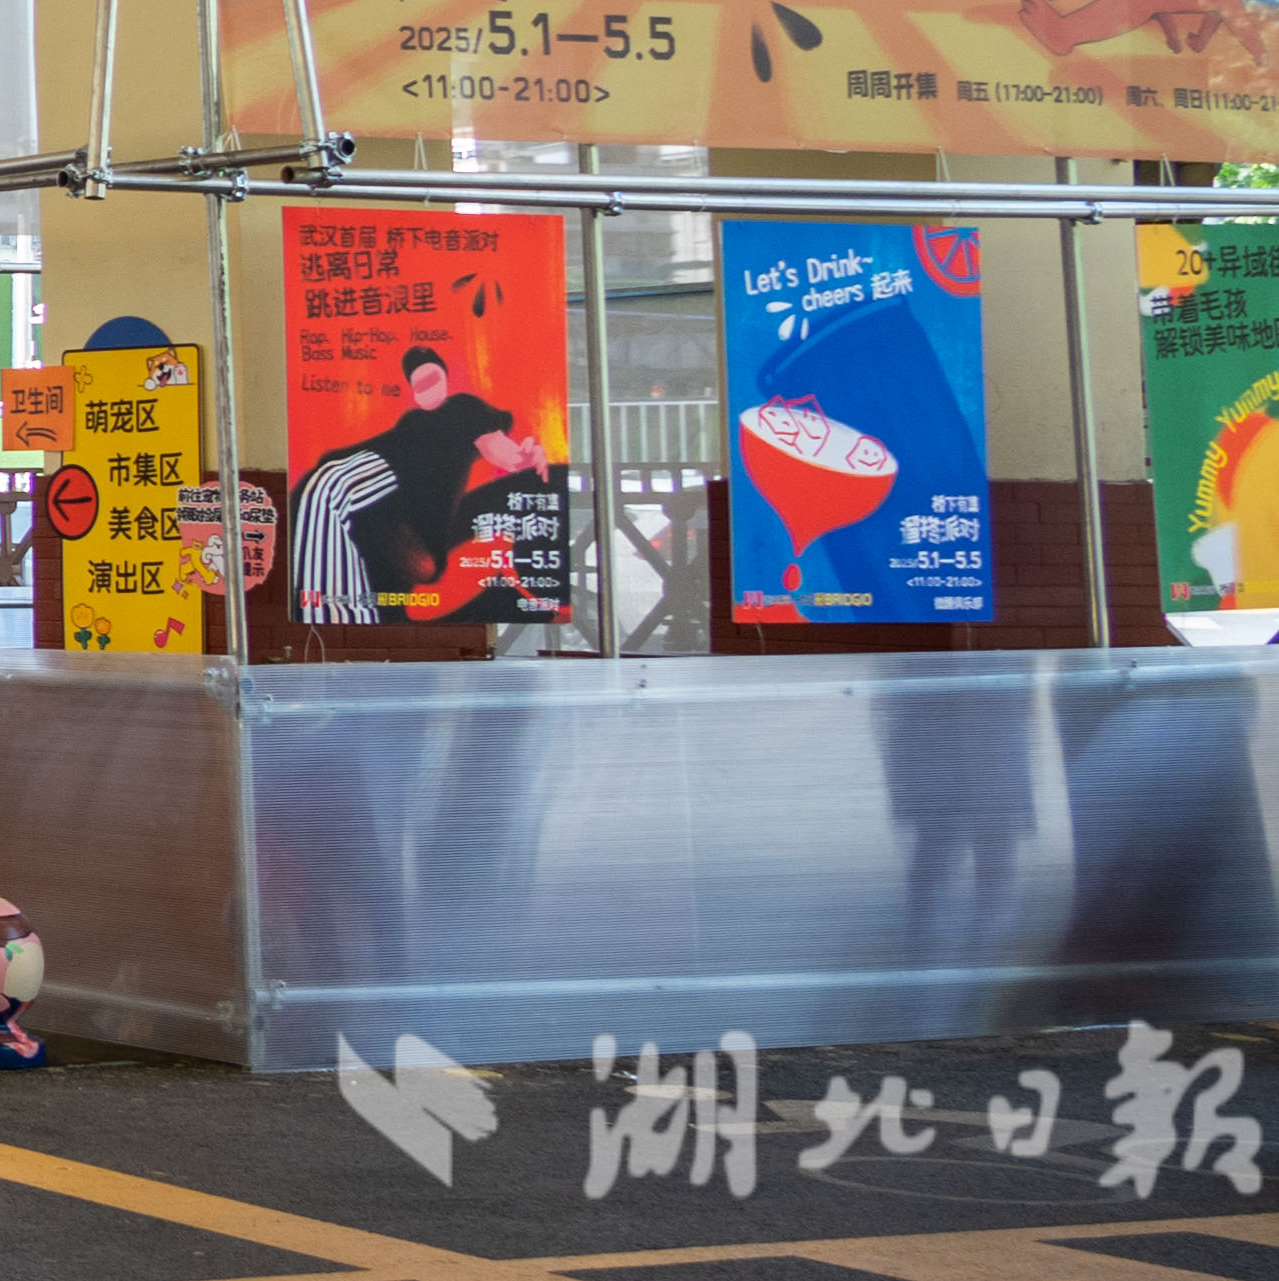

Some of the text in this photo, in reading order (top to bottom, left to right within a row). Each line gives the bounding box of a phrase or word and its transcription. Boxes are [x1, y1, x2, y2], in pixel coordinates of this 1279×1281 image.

[401, 73, 611, 104] <11:00-21:00>
[847, 70, 938, 100] 周周开集
[956, 80, 990, 103] 周五
[299, 225, 499, 252] 武汉首届 桥下电音派对
[300, 250, 400, 282] 逃离日常
[305, 282, 437, 318] 跳进音浪里
[803, 270, 914, 312] cheers 起来
[1151, 289, 1248, 325] 带着毛孩
[1155, 317, 1279, 360] 解锁美味地
[10, 385, 64, 415] 卫生间
[301, 373, 401, 397] Listen to me
[84, 398, 160, 434] 萌宠区
[108, 452, 184, 487] 市集区
[507, 492, 559, 511] 桥下有集
[1189, 441, 1227, 534] Yummy
[108, 506, 181, 541] 美食区
[471, 513, 560, 543] 遛搭派对
[88, 560, 165, 595] 演出区
